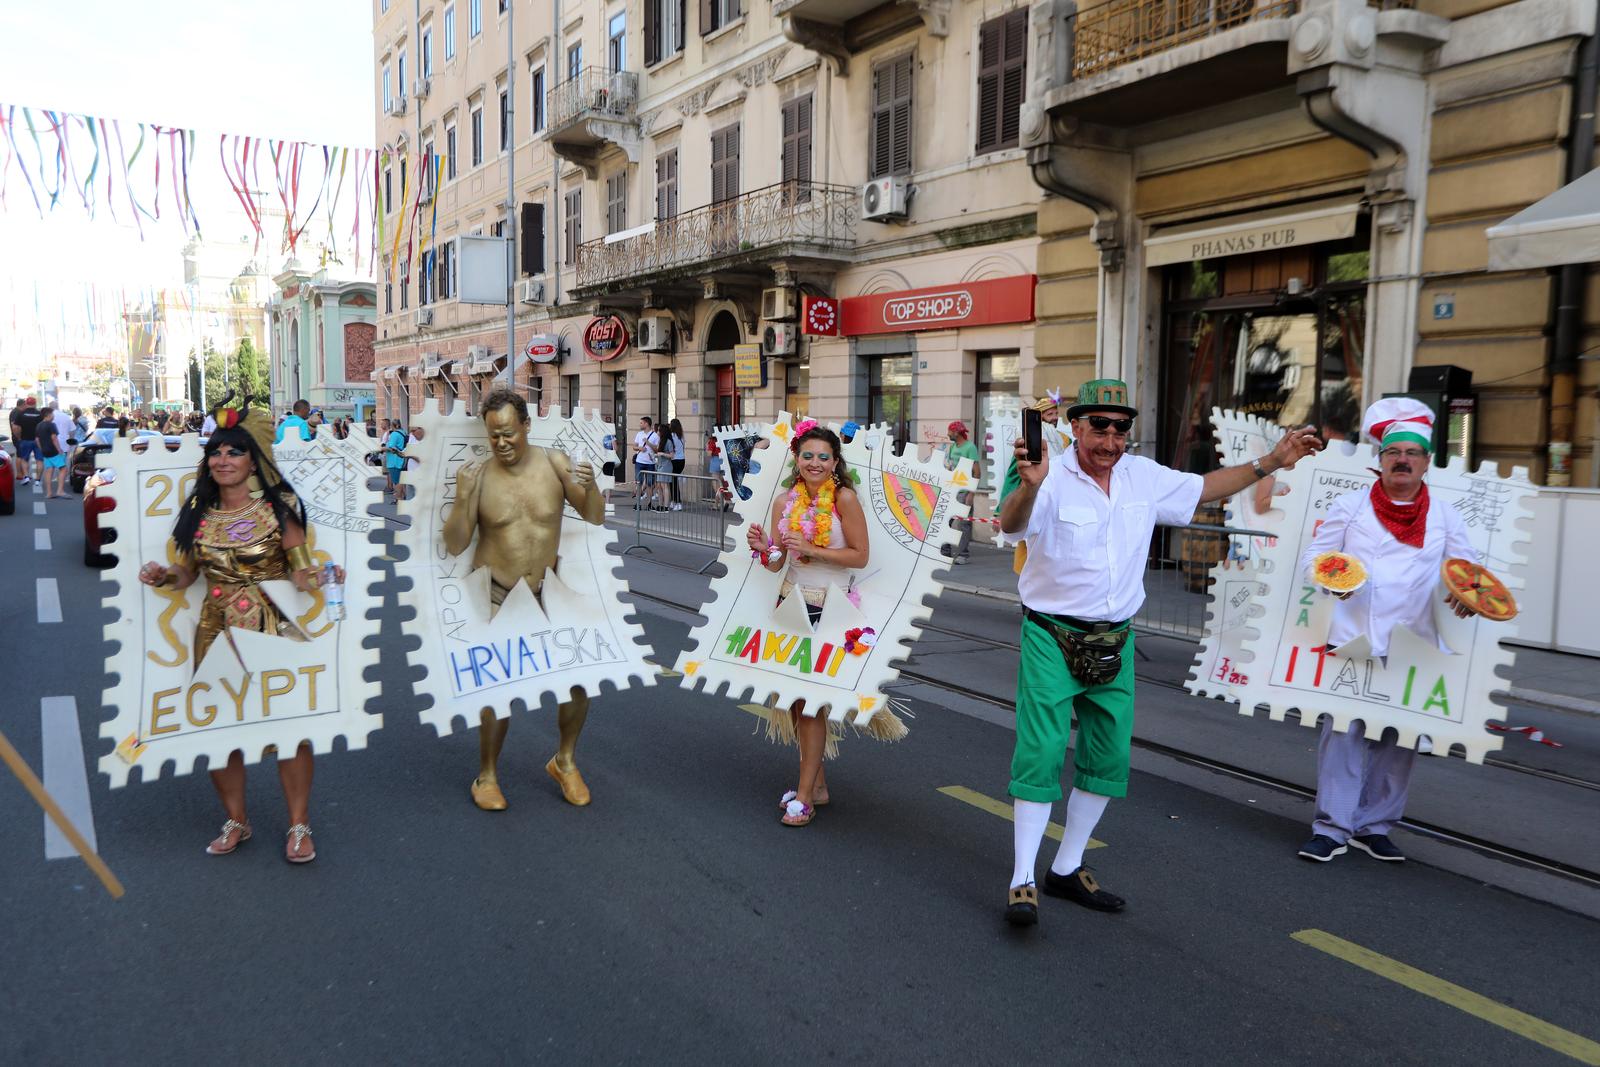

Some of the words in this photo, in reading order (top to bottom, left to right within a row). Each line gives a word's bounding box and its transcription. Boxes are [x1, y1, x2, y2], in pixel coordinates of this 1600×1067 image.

[1192, 236, 1255, 258] PHANAS
[1262, 229, 1295, 247] PUB
[590, 323, 616, 340] ROST
[890, 302, 915, 320] TOP
[917, 298, 954, 317] SHOP
[886, 462, 941, 486] LOŠINJSKI
[871, 477, 888, 516] RIJEKA
[884, 518, 914, 547] 2022
[451, 626, 618, 692] HRVATSKA
[726, 626, 847, 678] HAWAII
[150, 664, 326, 735] EGYPT
[1285, 645, 1450, 717] ITALIA
